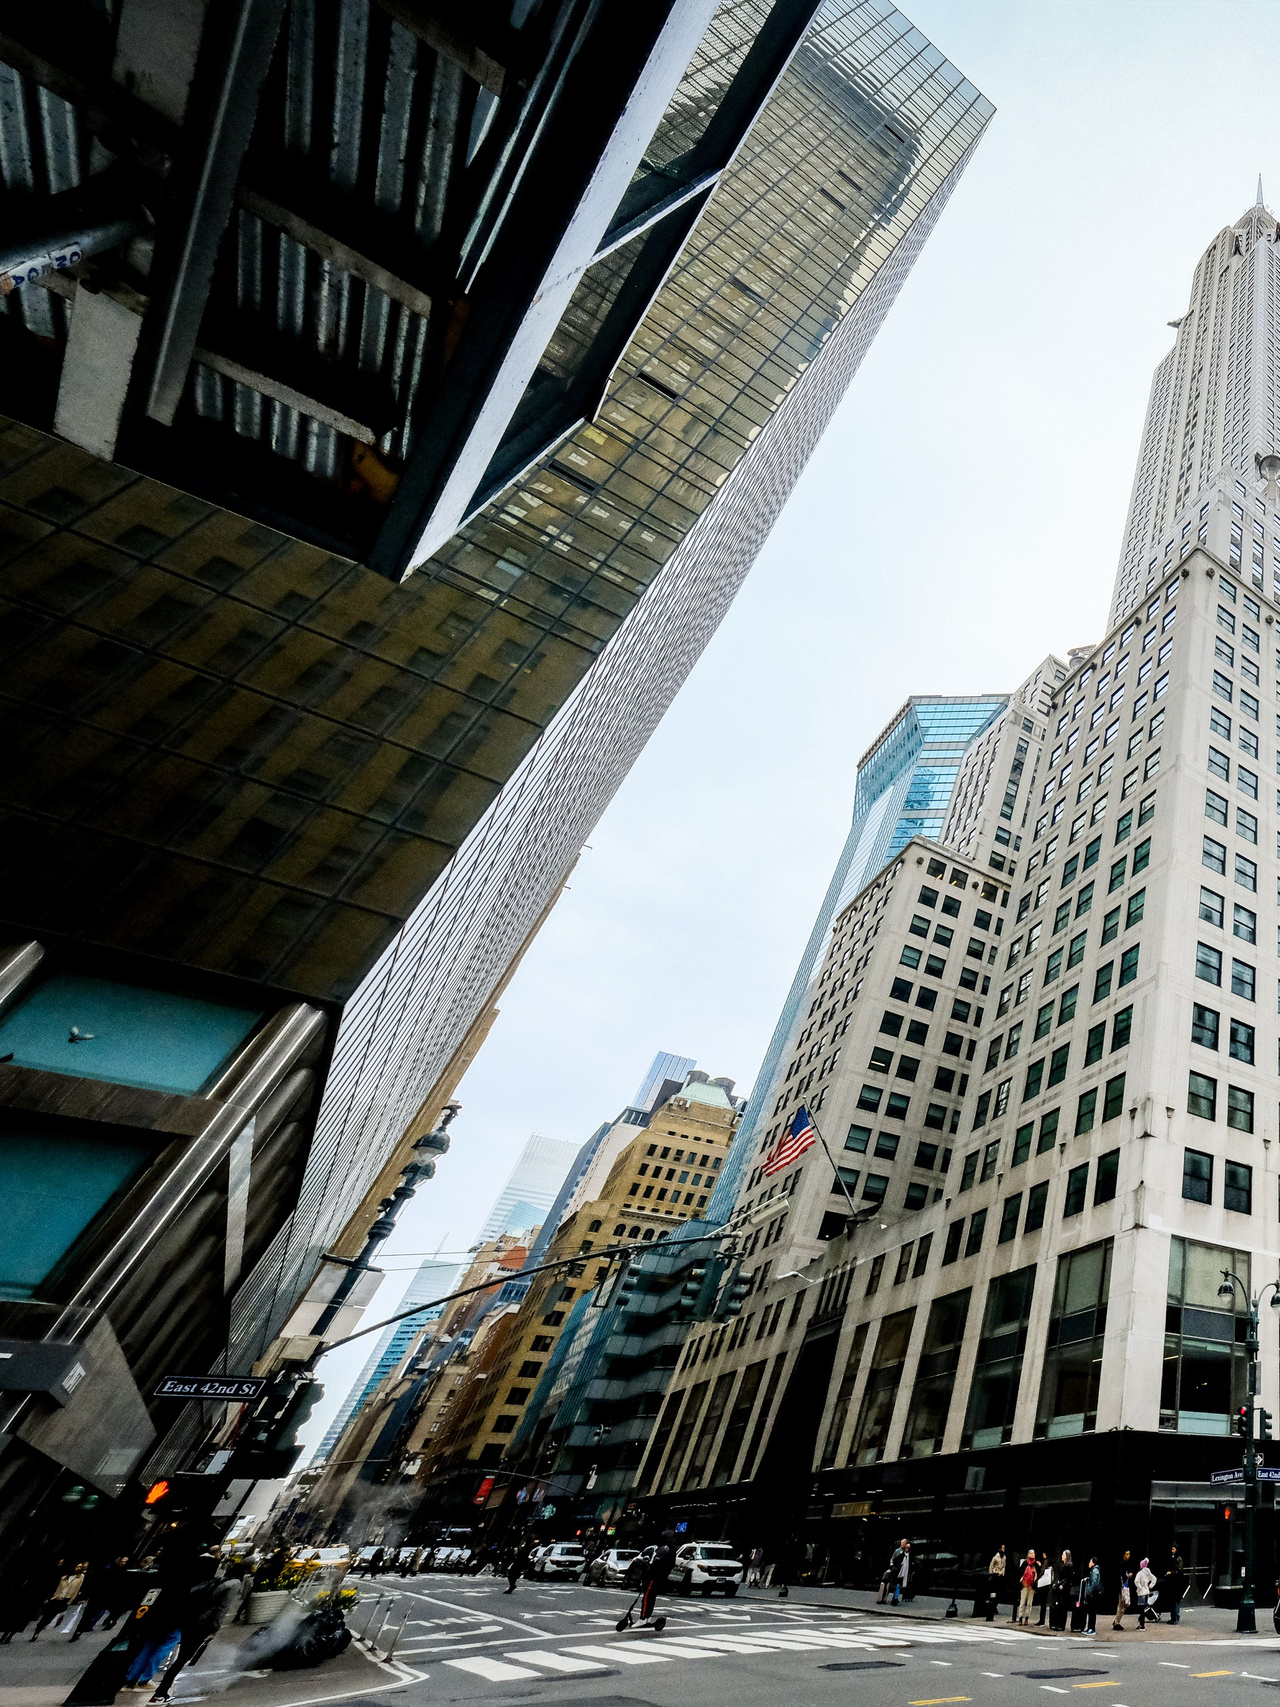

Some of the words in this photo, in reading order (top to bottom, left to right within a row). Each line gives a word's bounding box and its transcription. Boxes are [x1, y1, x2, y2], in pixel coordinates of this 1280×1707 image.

[161, 1380, 198, 1393] East
[200, 1382, 238, 1394] 42nd
[239, 1383, 257, 1395] St
[1211, 1473, 1234, 1482] Lexington
[1234, 1471, 1243, 1479] Ave
